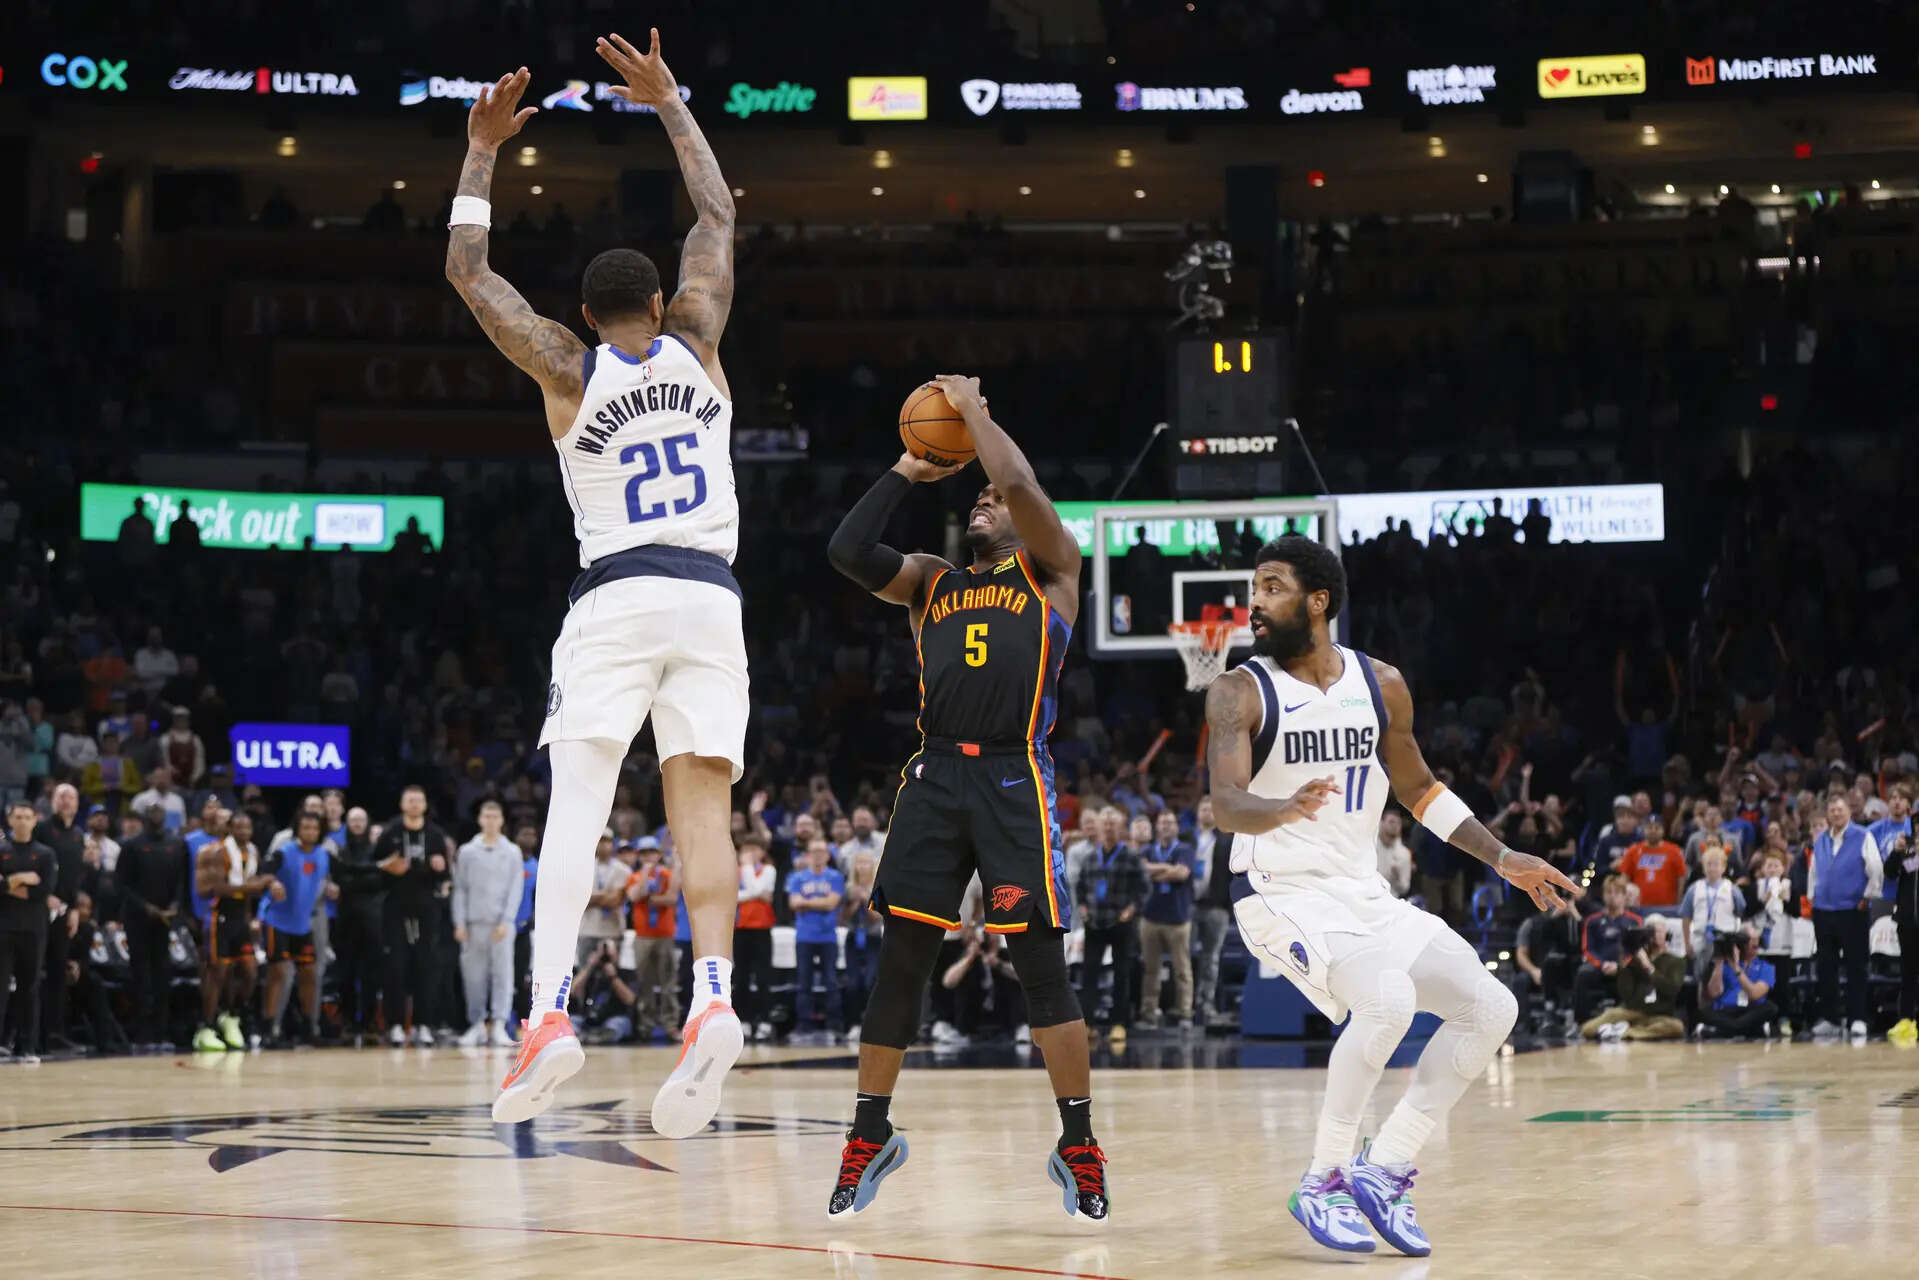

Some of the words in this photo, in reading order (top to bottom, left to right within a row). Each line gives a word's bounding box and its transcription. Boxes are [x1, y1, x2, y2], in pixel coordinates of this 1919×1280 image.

[41, 53, 128, 91] COX
[272, 71, 360, 96] ULTRA
[724, 81, 817, 119] Sprite
[1280, 89, 1363, 115] devon
[1214, 341, 1251, 373] 1.1
[575, 383, 696, 456] WASHINGTON
[695, 397, 722, 430] JR.
[1206, 436, 1278, 454] TISSOT
[620, 432, 708, 525] 25
[241, 500, 302, 545] out
[931, 585, 1028, 625] OKLAHOMA
[965, 623, 989, 667] 5
[236, 739, 346, 770] ULTRA
[1284, 727, 1374, 764] DALLAS
[1345, 765, 1371, 813] 11
